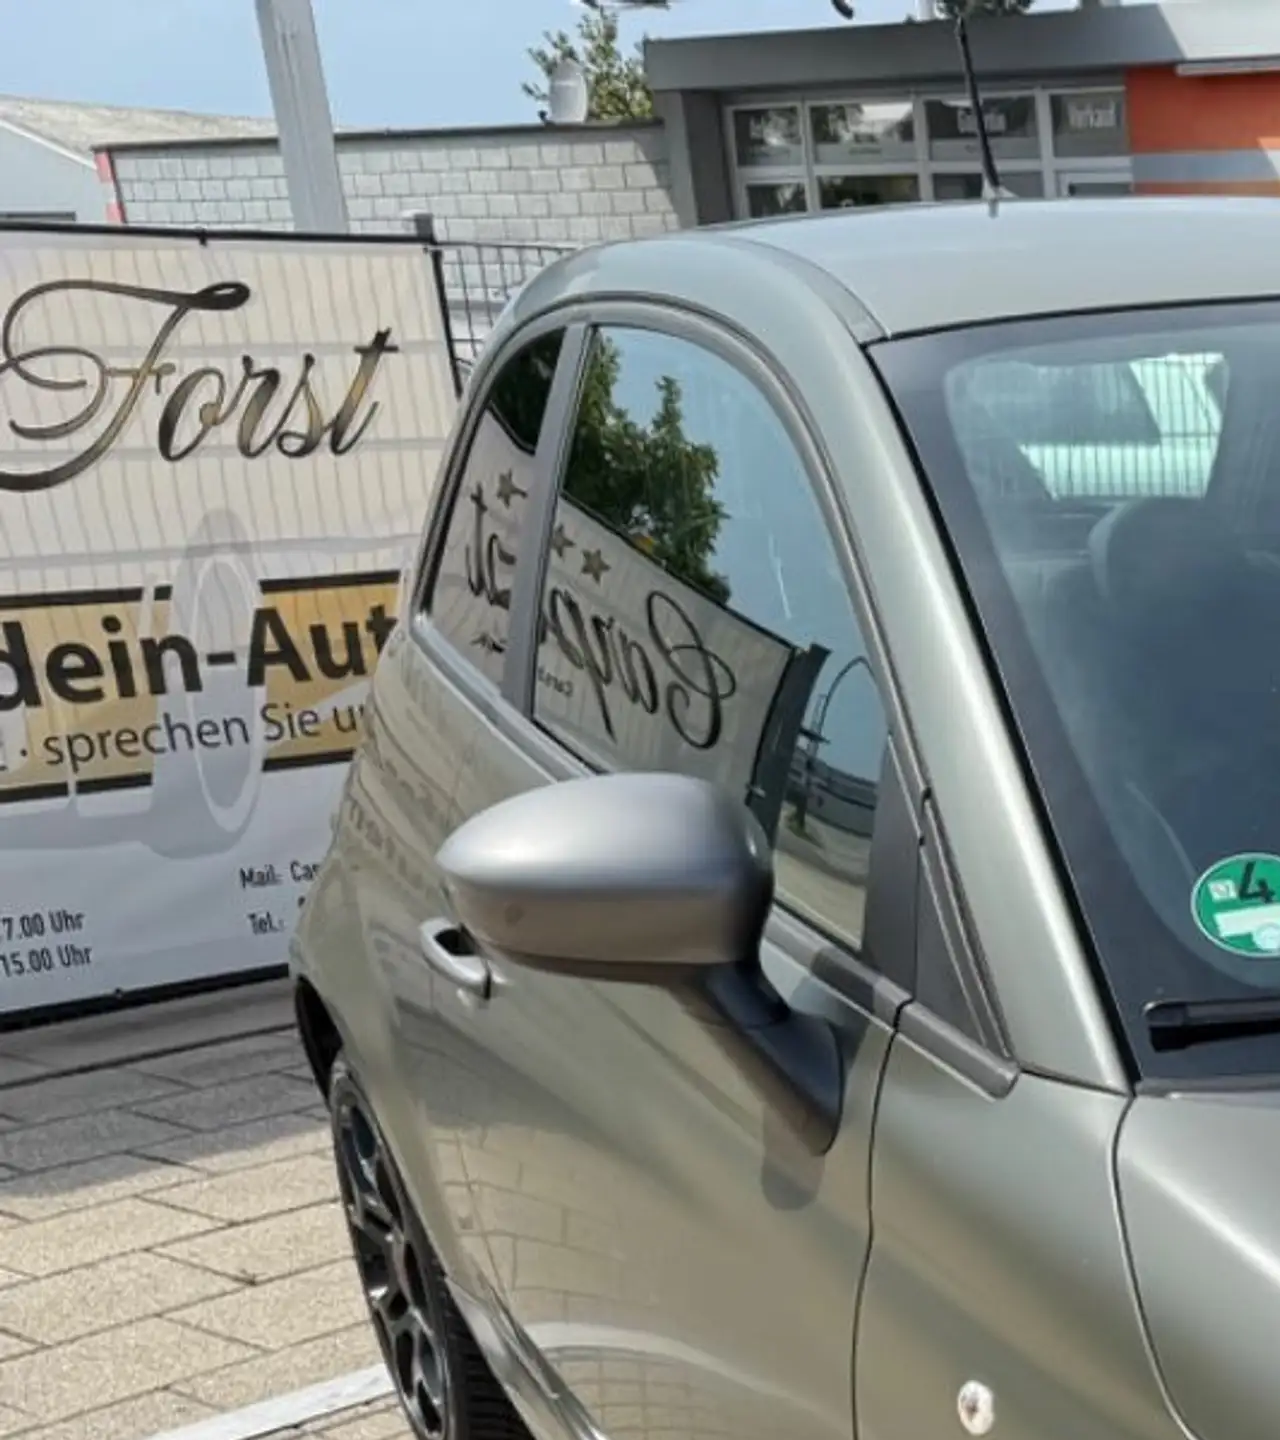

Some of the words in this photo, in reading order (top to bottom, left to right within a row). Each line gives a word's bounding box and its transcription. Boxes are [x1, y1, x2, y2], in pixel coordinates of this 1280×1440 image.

[0, 279, 399, 492] Forst
[43, 713, 249, 774] sprechen
[261, 701, 320, 742] Sie
[331, 703, 365, 733] u
[1239, 861, 1276, 904] 4
[0, 912, 45, 941] 7.00
[48, 910, 86, 933] Uhr
[56, 943, 92, 969] Uhr
